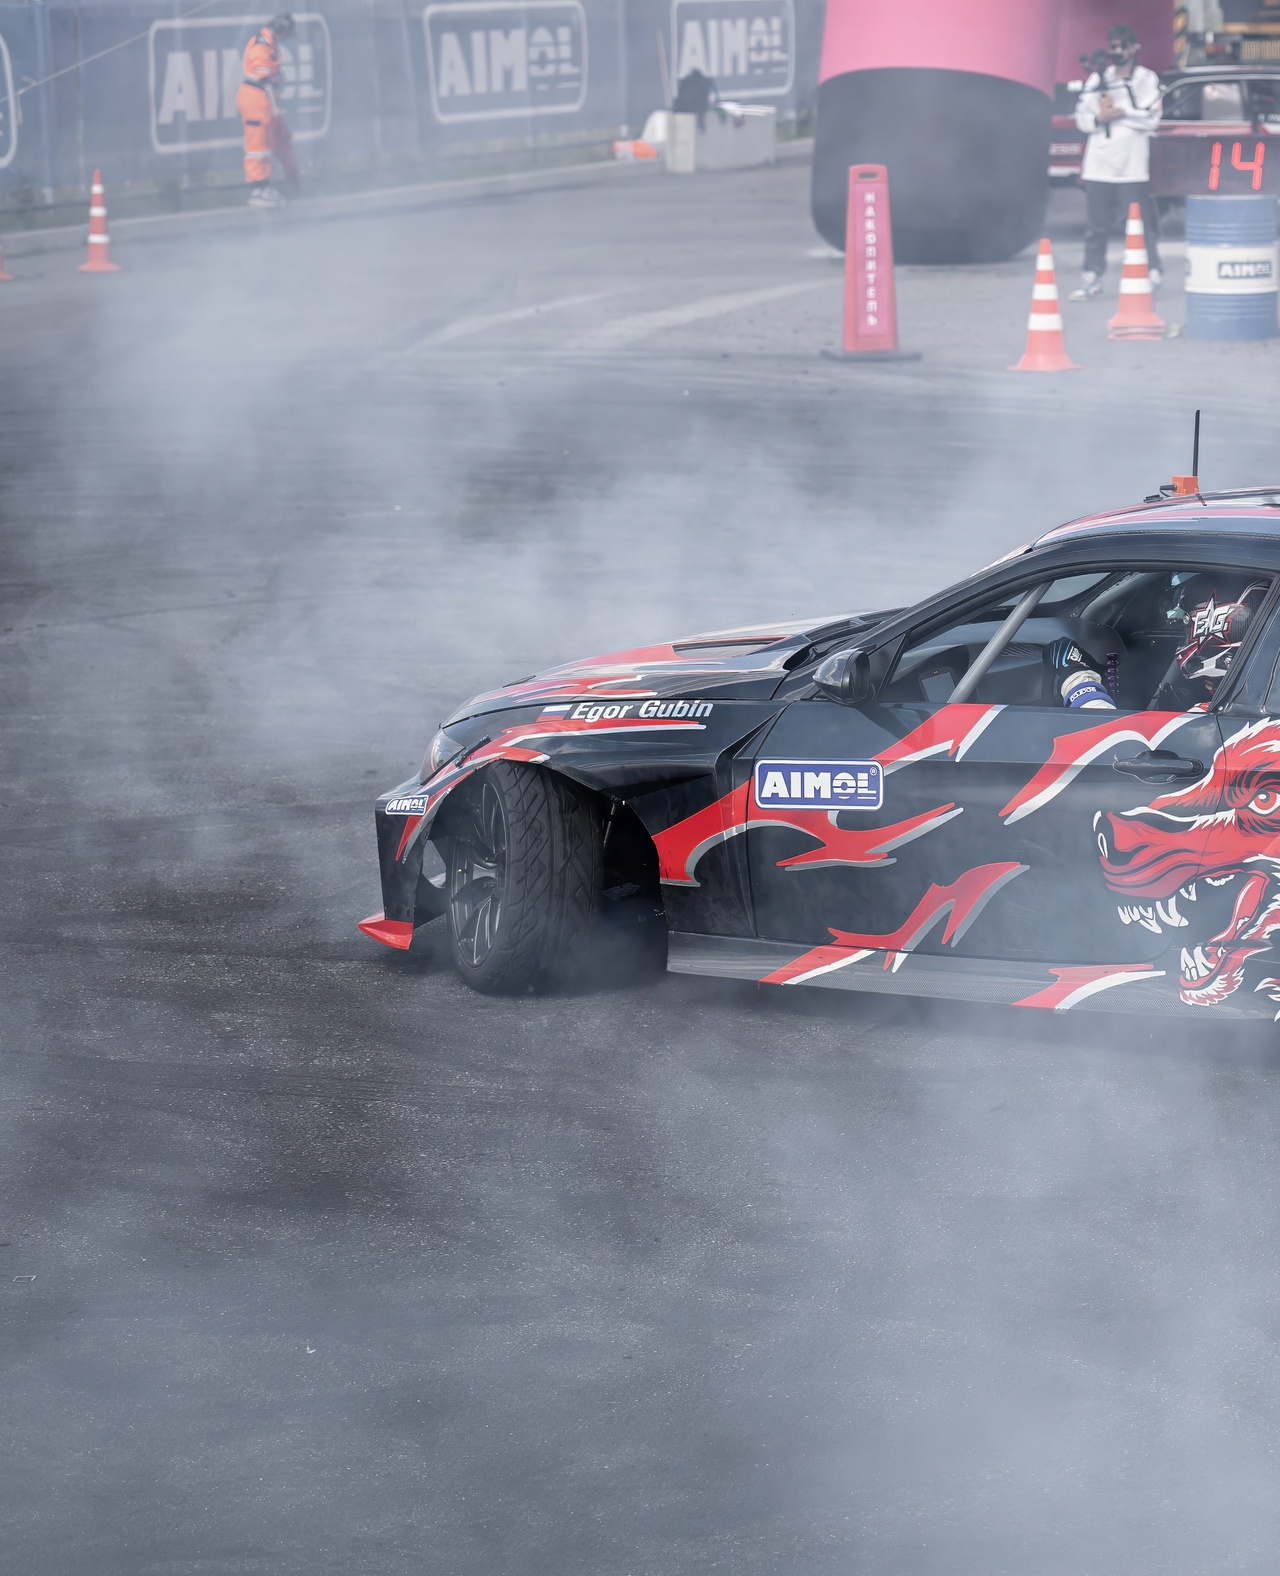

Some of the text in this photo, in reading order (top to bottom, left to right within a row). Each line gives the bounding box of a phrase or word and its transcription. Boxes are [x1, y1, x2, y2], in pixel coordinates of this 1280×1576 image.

[438, 26, 581, 97] AIMOL
[678, 16, 788, 78] AIMOL
[864, 191, 878, 326] НАКОПИТЕЛЬ
[570, 700, 714, 723] Egor Gubin
